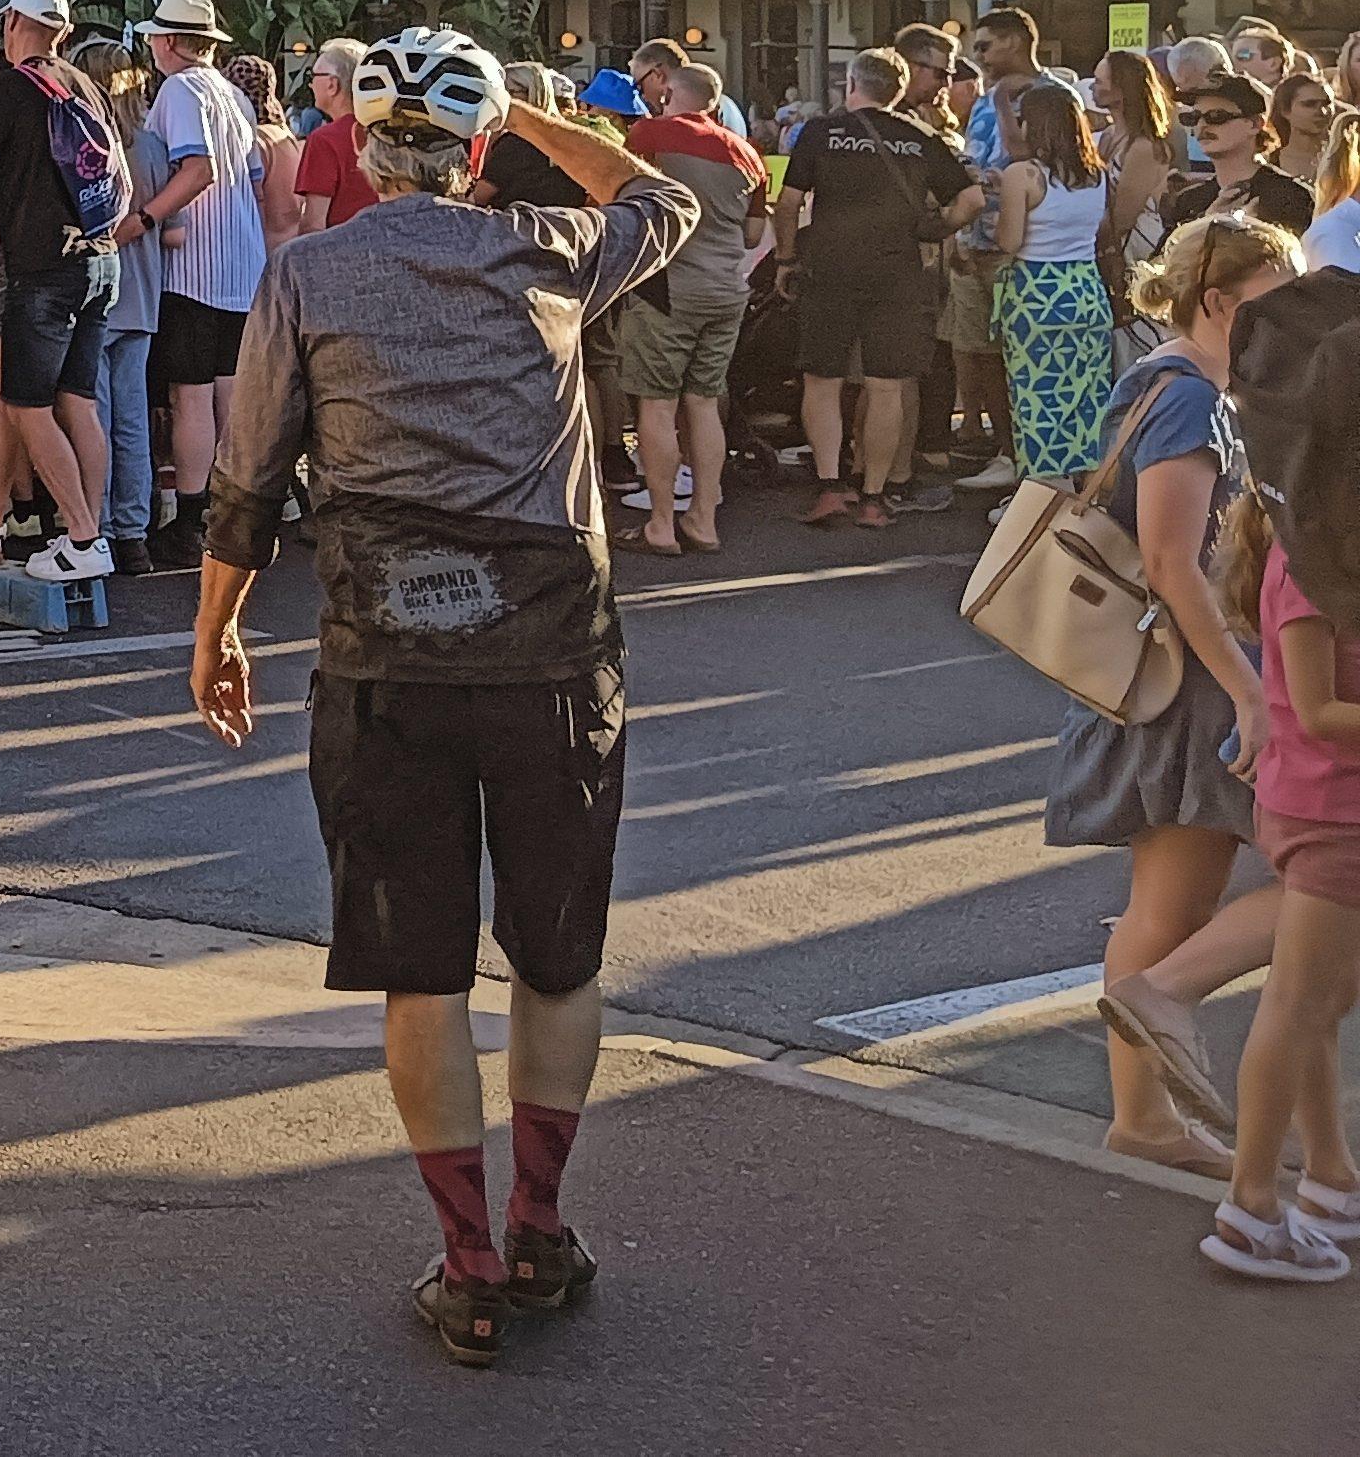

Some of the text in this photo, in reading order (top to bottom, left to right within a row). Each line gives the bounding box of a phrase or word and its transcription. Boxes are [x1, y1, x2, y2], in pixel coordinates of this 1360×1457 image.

[1113, 28, 1143, 37] KEEP
[1113, 37, 1143, 47] CLEAR
[399, 568, 478, 597] GARBANZO
[449, 586, 482, 603] BEAN
